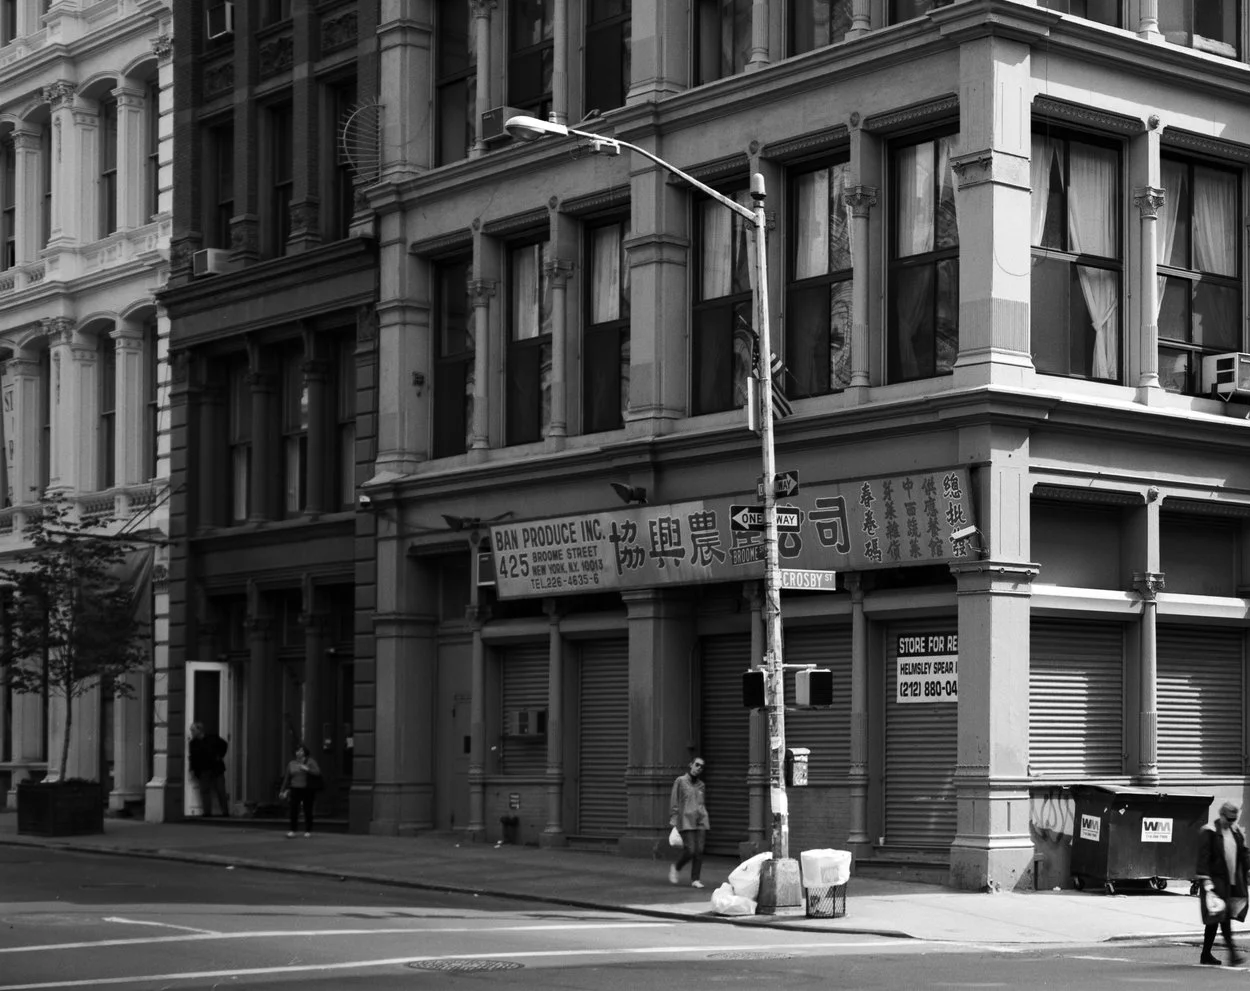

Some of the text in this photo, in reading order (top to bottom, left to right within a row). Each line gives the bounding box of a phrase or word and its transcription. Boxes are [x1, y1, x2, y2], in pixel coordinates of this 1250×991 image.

[741, 513, 763, 524] ONE
[495, 519, 606, 551] BAN PRODUCE INC.
[532, 545, 598, 563] BROOME STREET
[733, 546, 759, 564] BROOME
[499, 553, 529, 578] 425
[532, 564, 547, 576] NEW
[581, 559, 604, 572] 10013
[782, 572, 833, 587] CROSBY ST
[899, 636, 925, 653] STORE
[928, 635, 945, 652] FOR
[900, 661, 932, 675] HELMSLEY
[933, 661, 953, 675] SPEAR
[900, 680, 958, 697] (212) 880-04
[1082, 818, 1098, 830] WM
[1144, 821, 1170, 832] WM
